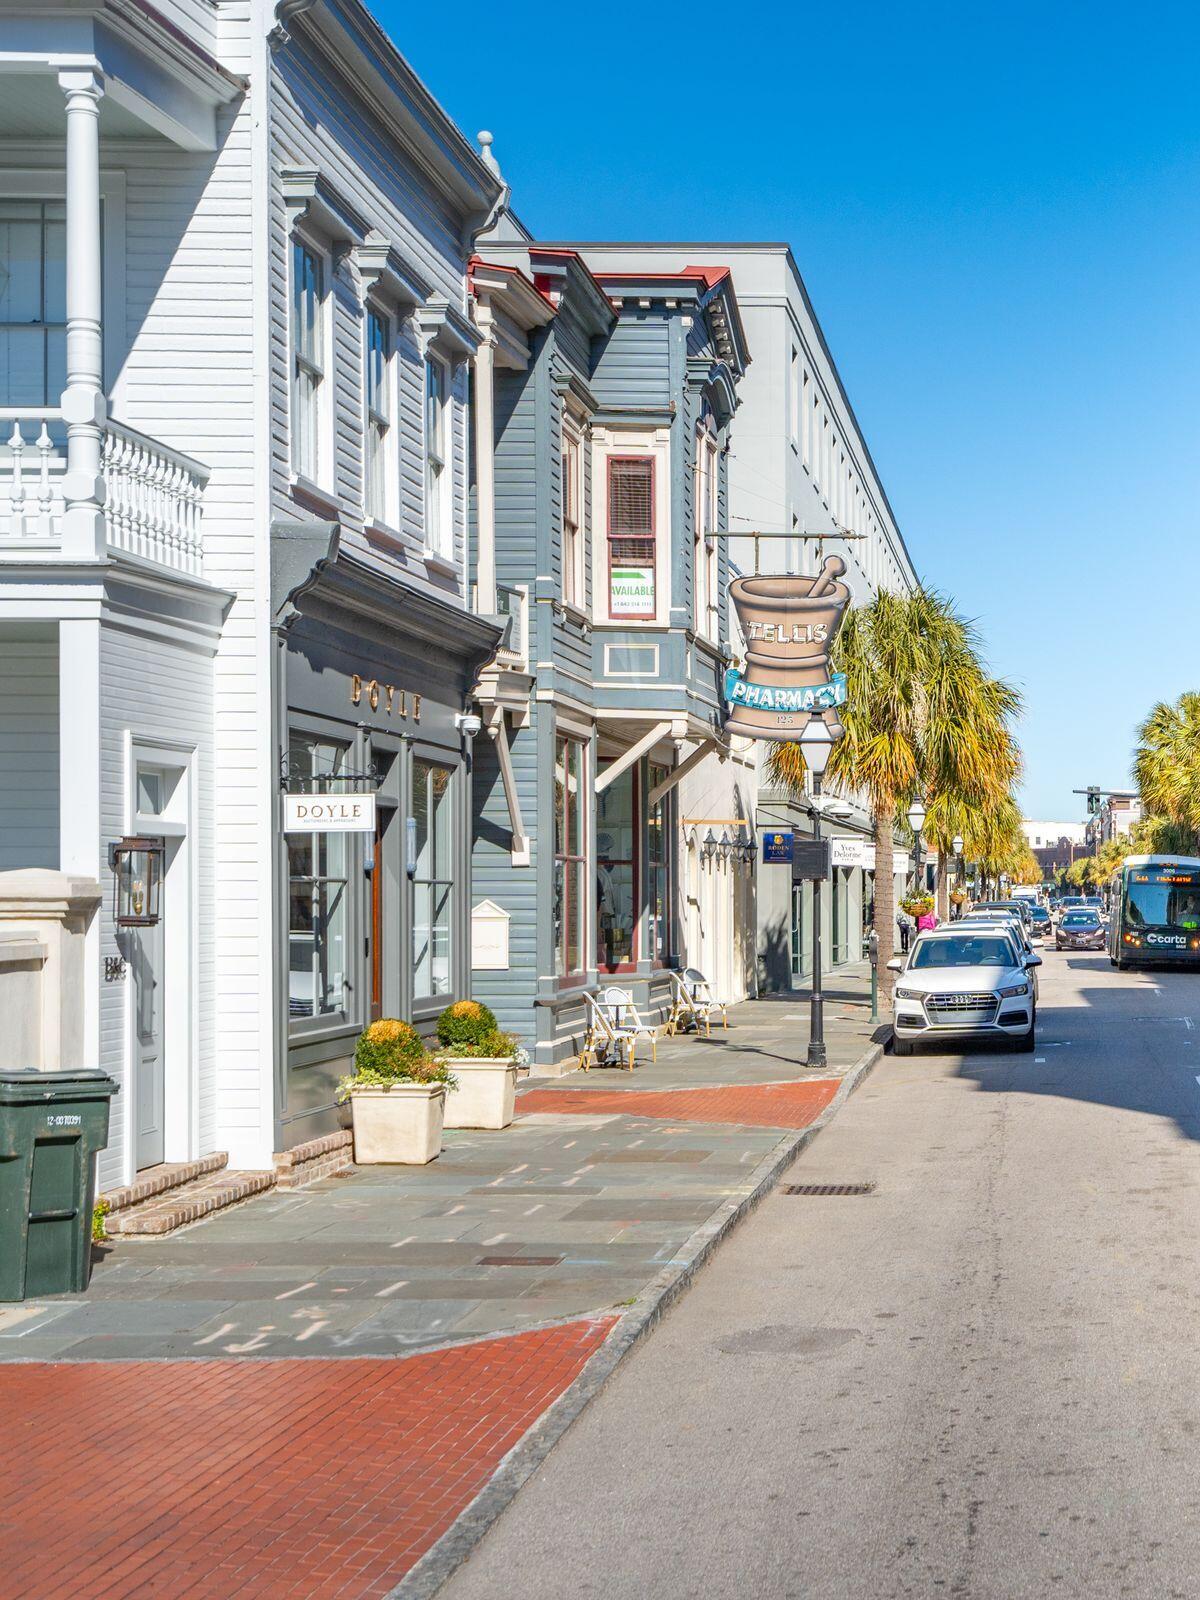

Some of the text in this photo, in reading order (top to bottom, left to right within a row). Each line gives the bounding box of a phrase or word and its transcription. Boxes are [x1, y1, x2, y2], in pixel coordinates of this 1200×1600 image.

[611, 586, 655, 596] AVAILABLE
[747, 621, 828, 644] TELLIS
[350, 674, 422, 720] DOYLE
[731, 682, 841, 708] PHARMACY
[297, 805, 361, 818] DOYLE
[1157, 935, 1186, 944] carta
